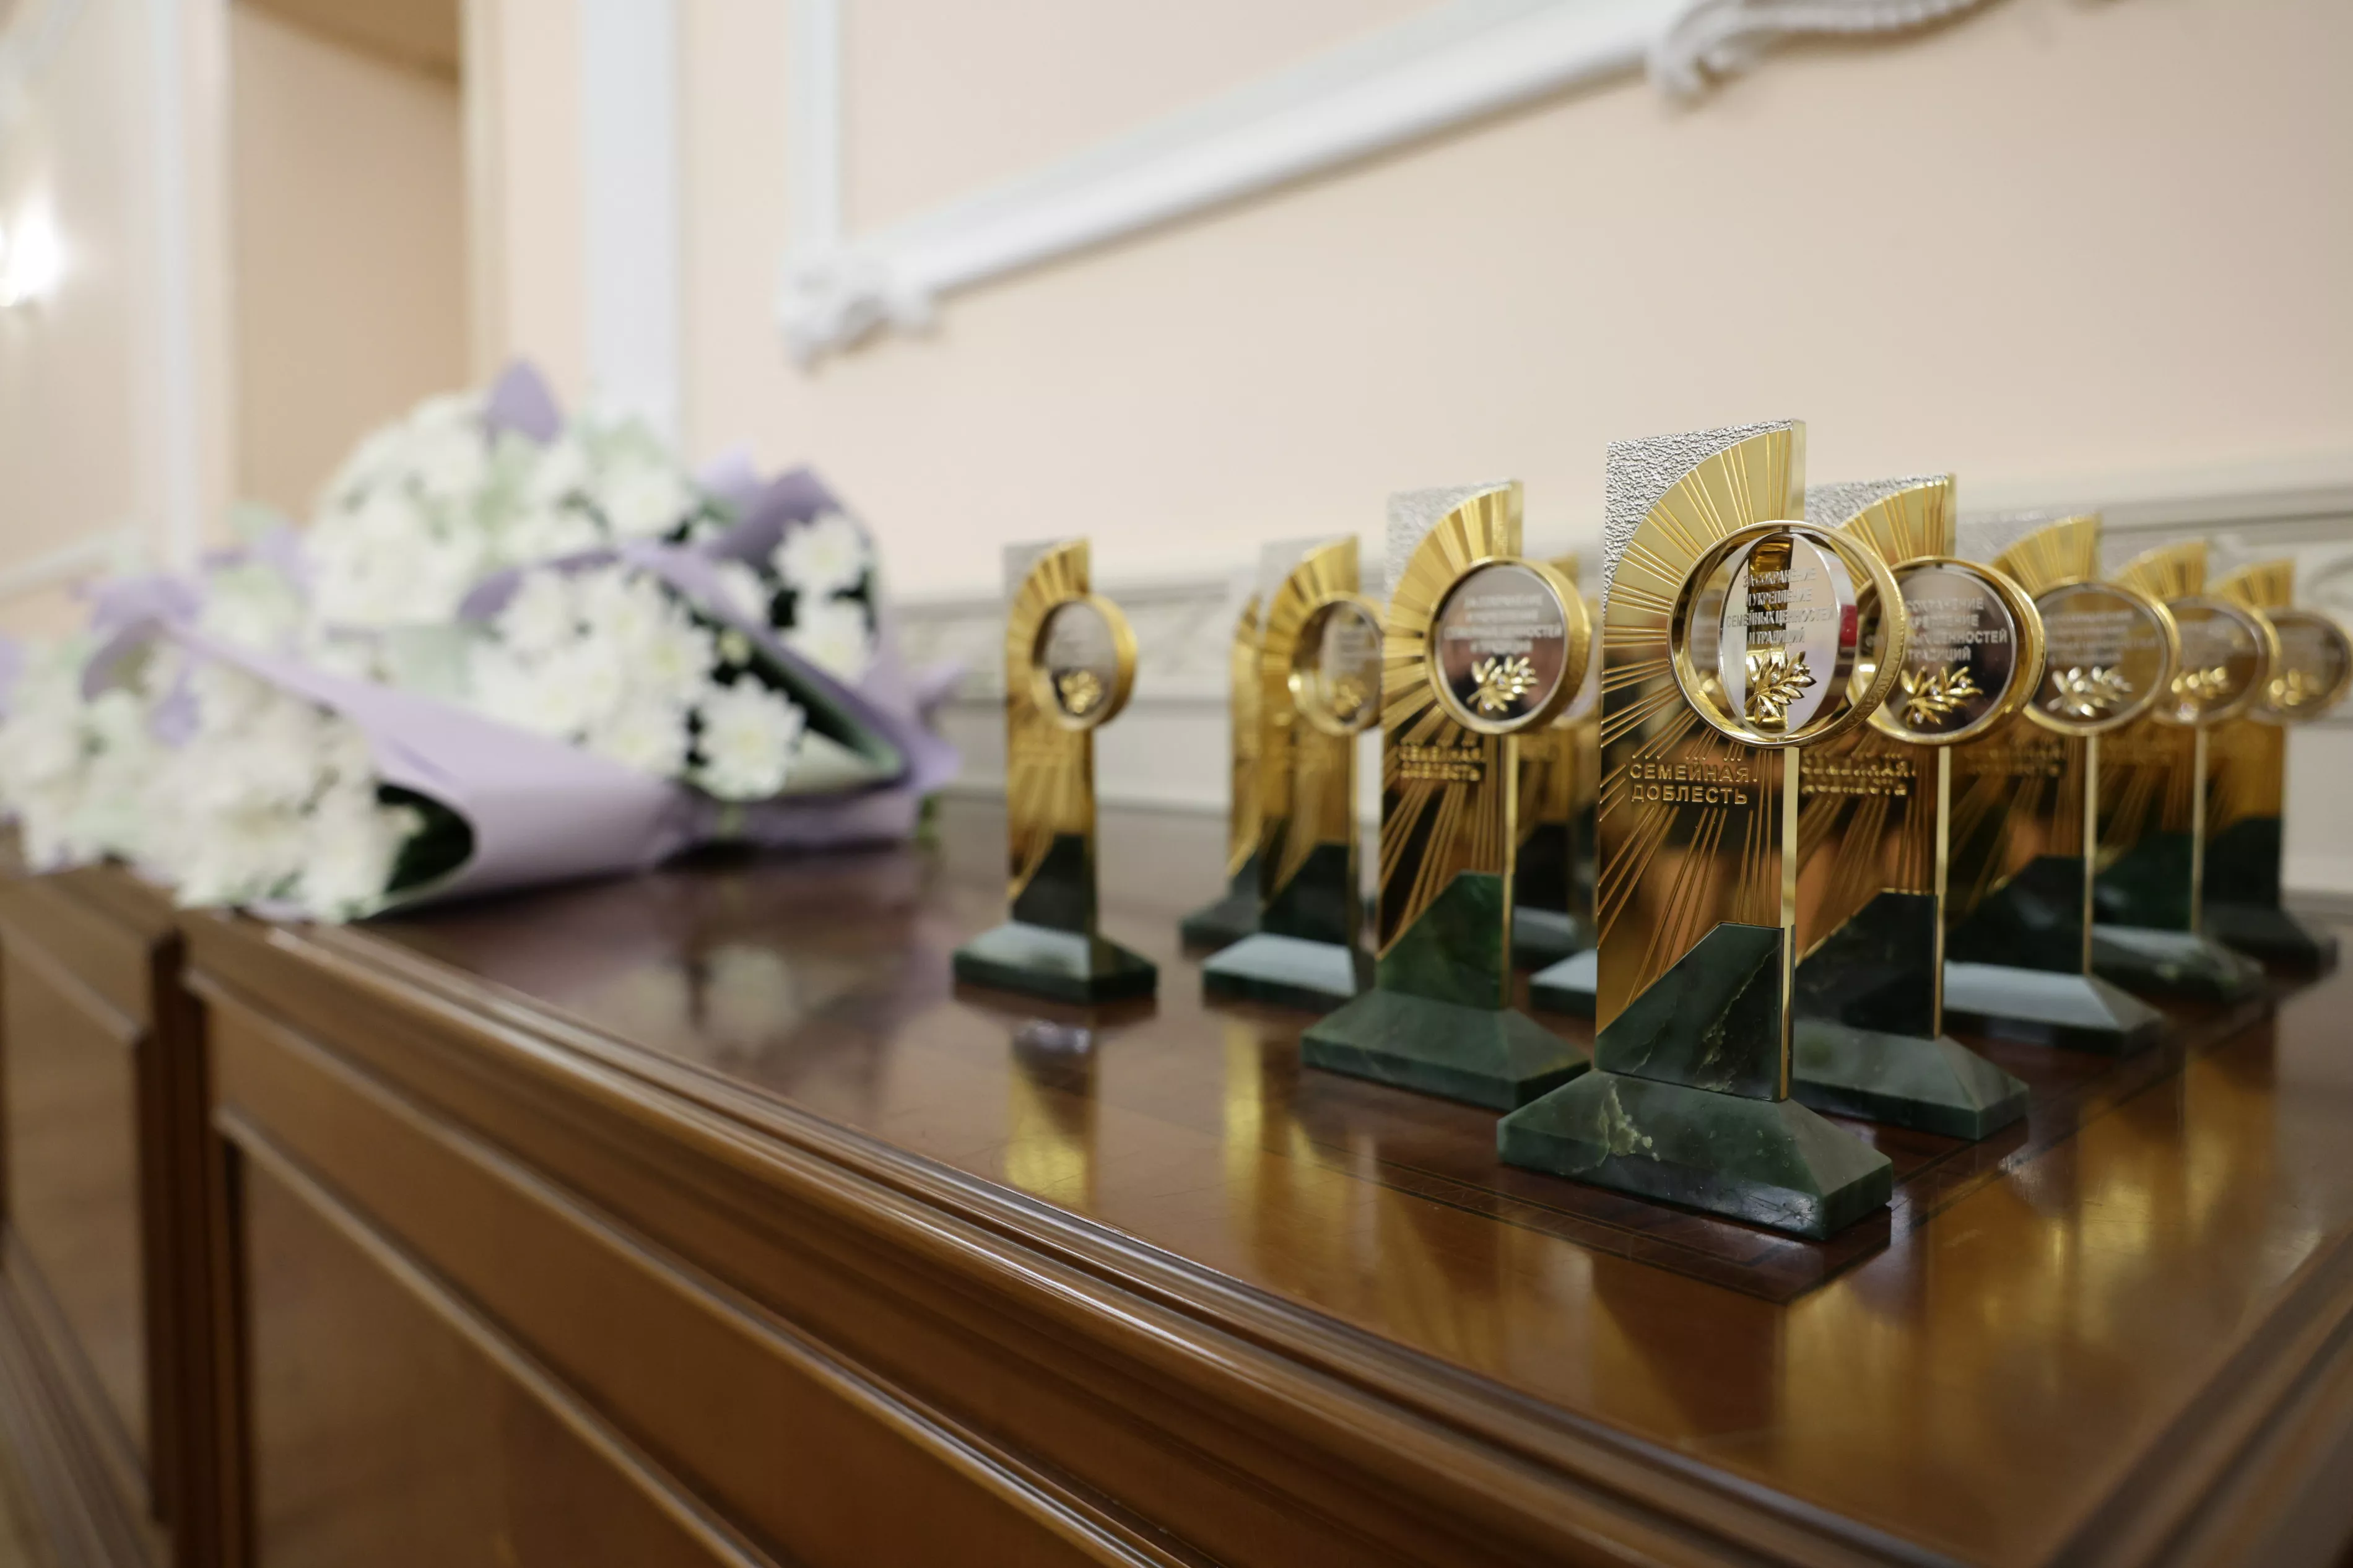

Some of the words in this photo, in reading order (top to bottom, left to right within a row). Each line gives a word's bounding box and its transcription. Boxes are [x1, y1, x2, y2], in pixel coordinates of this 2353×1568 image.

[1755, 567, 1816, 585] СОХРАНЕНИЕ
[1752, 588, 1812, 607] УКРЕПЛЕНИЕ
[1726, 609, 1775, 628] СЕМЕЙНЫХ
[1775, 603, 1835, 626] ЦЕННОСТЕЙ
[1755, 626, 1805, 647] ТРАДИЦИЙ
[1630, 760, 1749, 783] СЕМЕЙНАЯ
[1631, 783, 1747, 804] ДОБЛЕСТЬ
